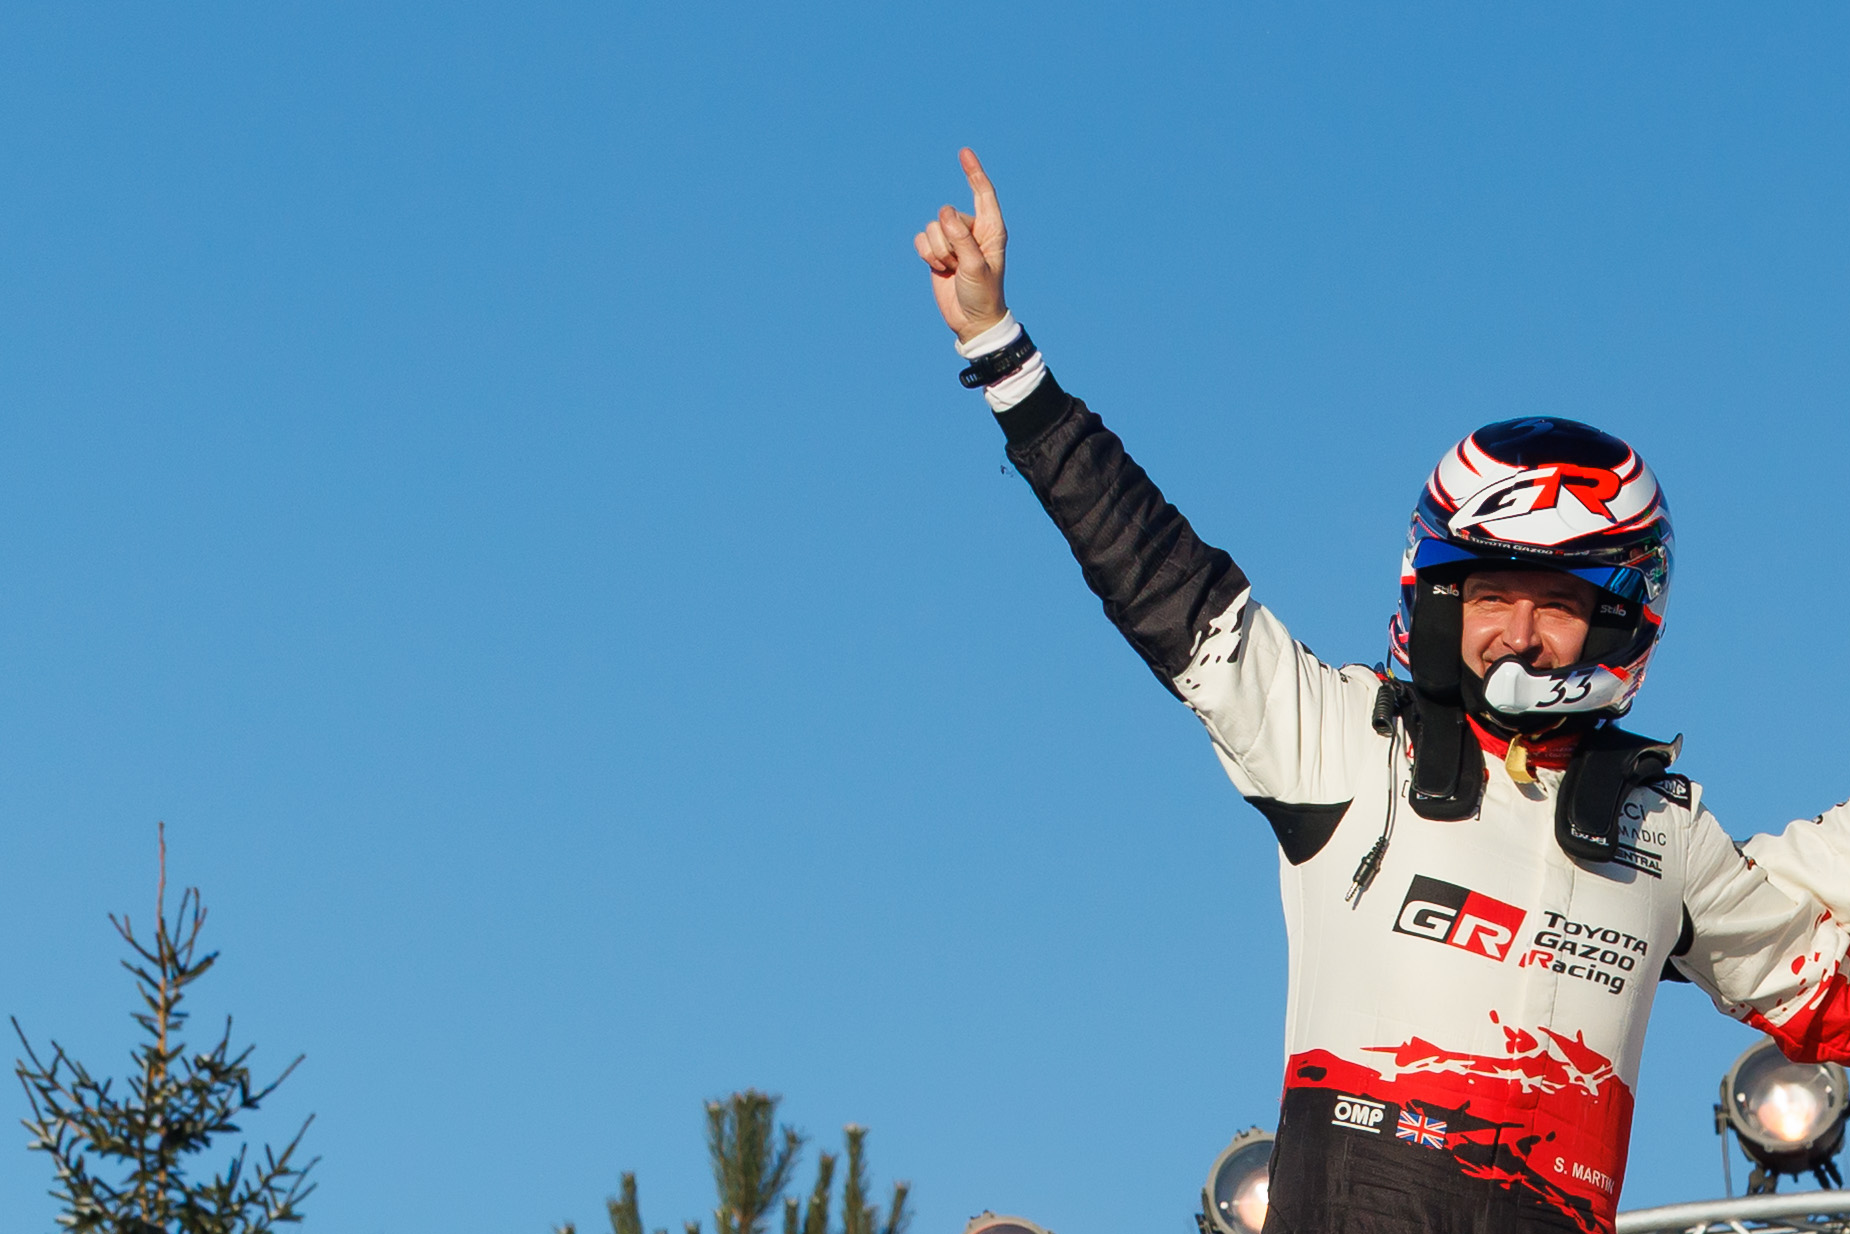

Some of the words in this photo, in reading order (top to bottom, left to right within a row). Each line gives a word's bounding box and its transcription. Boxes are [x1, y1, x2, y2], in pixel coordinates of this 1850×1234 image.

[1448, 464, 1622, 526] GR
[1470, 536, 1511, 549] TOYOTA
[1512, 543, 1553, 555] GAZOO
[1536, 667, 1592, 707] 33
[1399, 900, 1512, 959] GR
[1544, 911, 1648, 956] TOYOTA
[1518, 949, 1626, 995] Racing
[1533, 931, 1635, 972] GAZOO
[1334, 1101, 1383, 1127] OMP
[1553, 1157, 1568, 1175] S.
[1572, 1163, 1614, 1195] MARTIN
